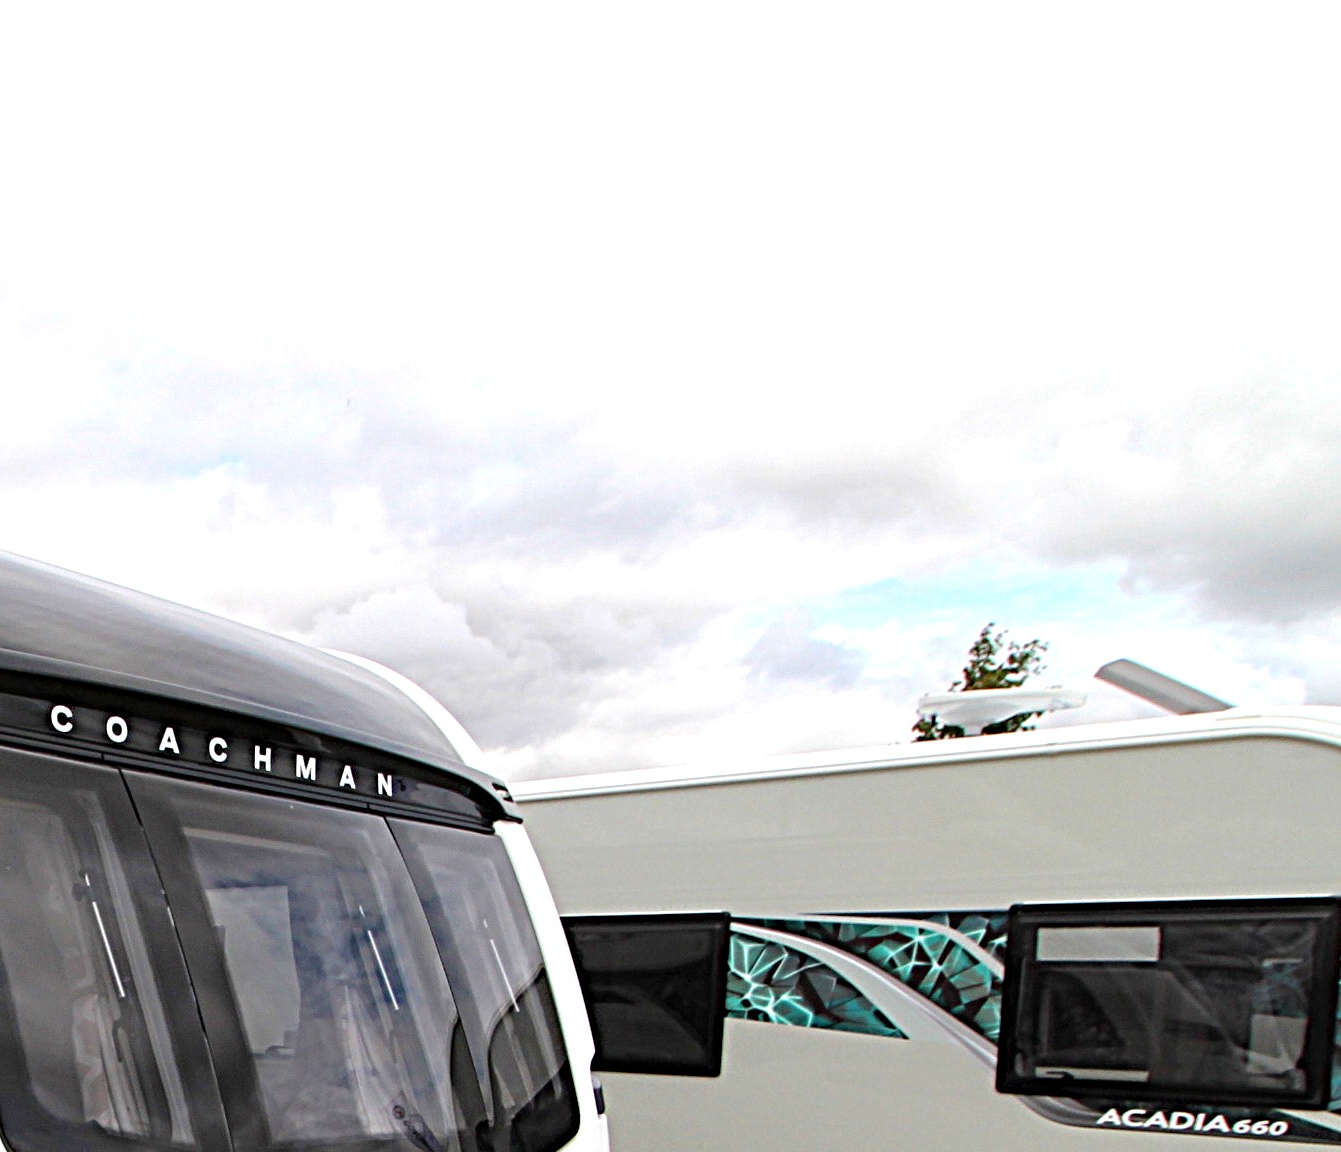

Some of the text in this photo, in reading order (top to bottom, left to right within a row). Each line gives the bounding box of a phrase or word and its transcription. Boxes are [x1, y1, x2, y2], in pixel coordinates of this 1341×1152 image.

[50, 704, 393, 797] COACHMAN
[1096, 1108, 1289, 1136] ACADIA 660
